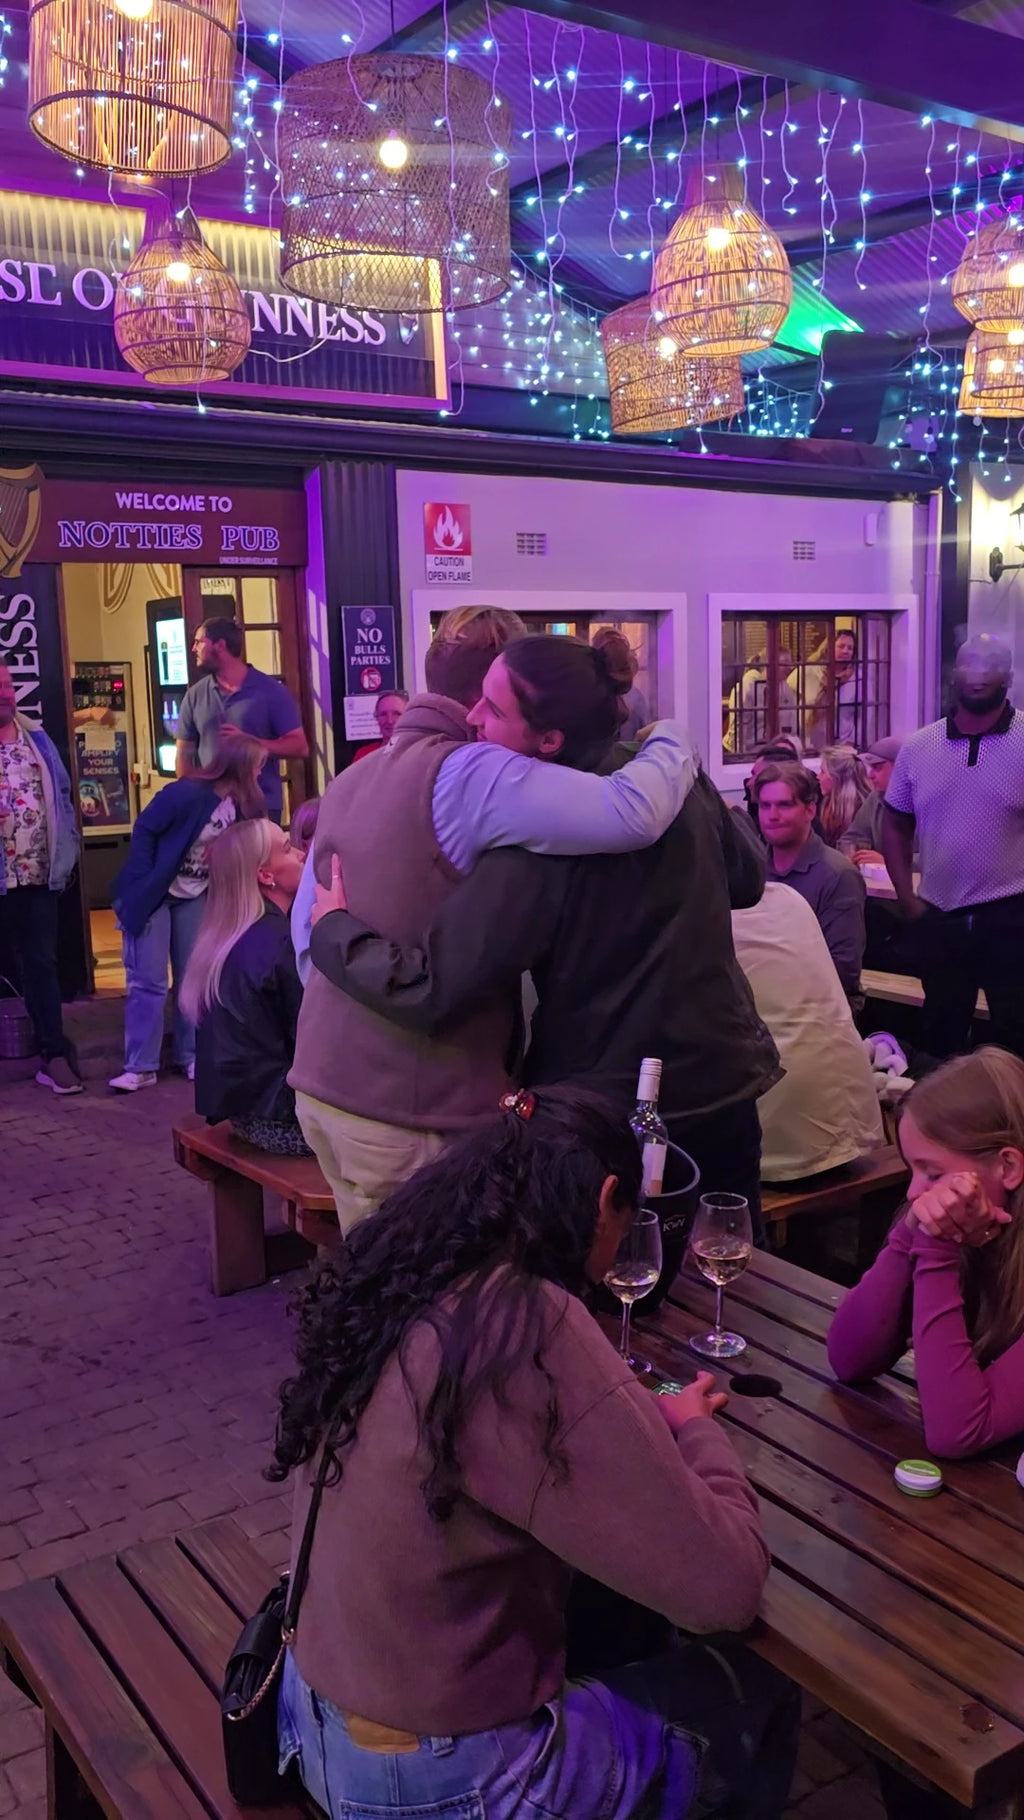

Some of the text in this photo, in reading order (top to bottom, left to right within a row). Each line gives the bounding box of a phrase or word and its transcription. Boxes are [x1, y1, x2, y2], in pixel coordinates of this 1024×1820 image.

[72, 268, 124, 310] O
[115, 492, 233, 513] WELCOME TO
[57, 520, 280, 551] NOTTIES PUB
[434, 556, 465, 567] CAUTION
[428, 571, 471, 581] OPEN FLAME
[357, 628, 383, 643] NO
[354, 645, 386, 655] BULLS
[351, 656, 391, 666] PARTIES
[88, 758, 113, 766] YOUR
[83, 766, 119, 775] SENSES
